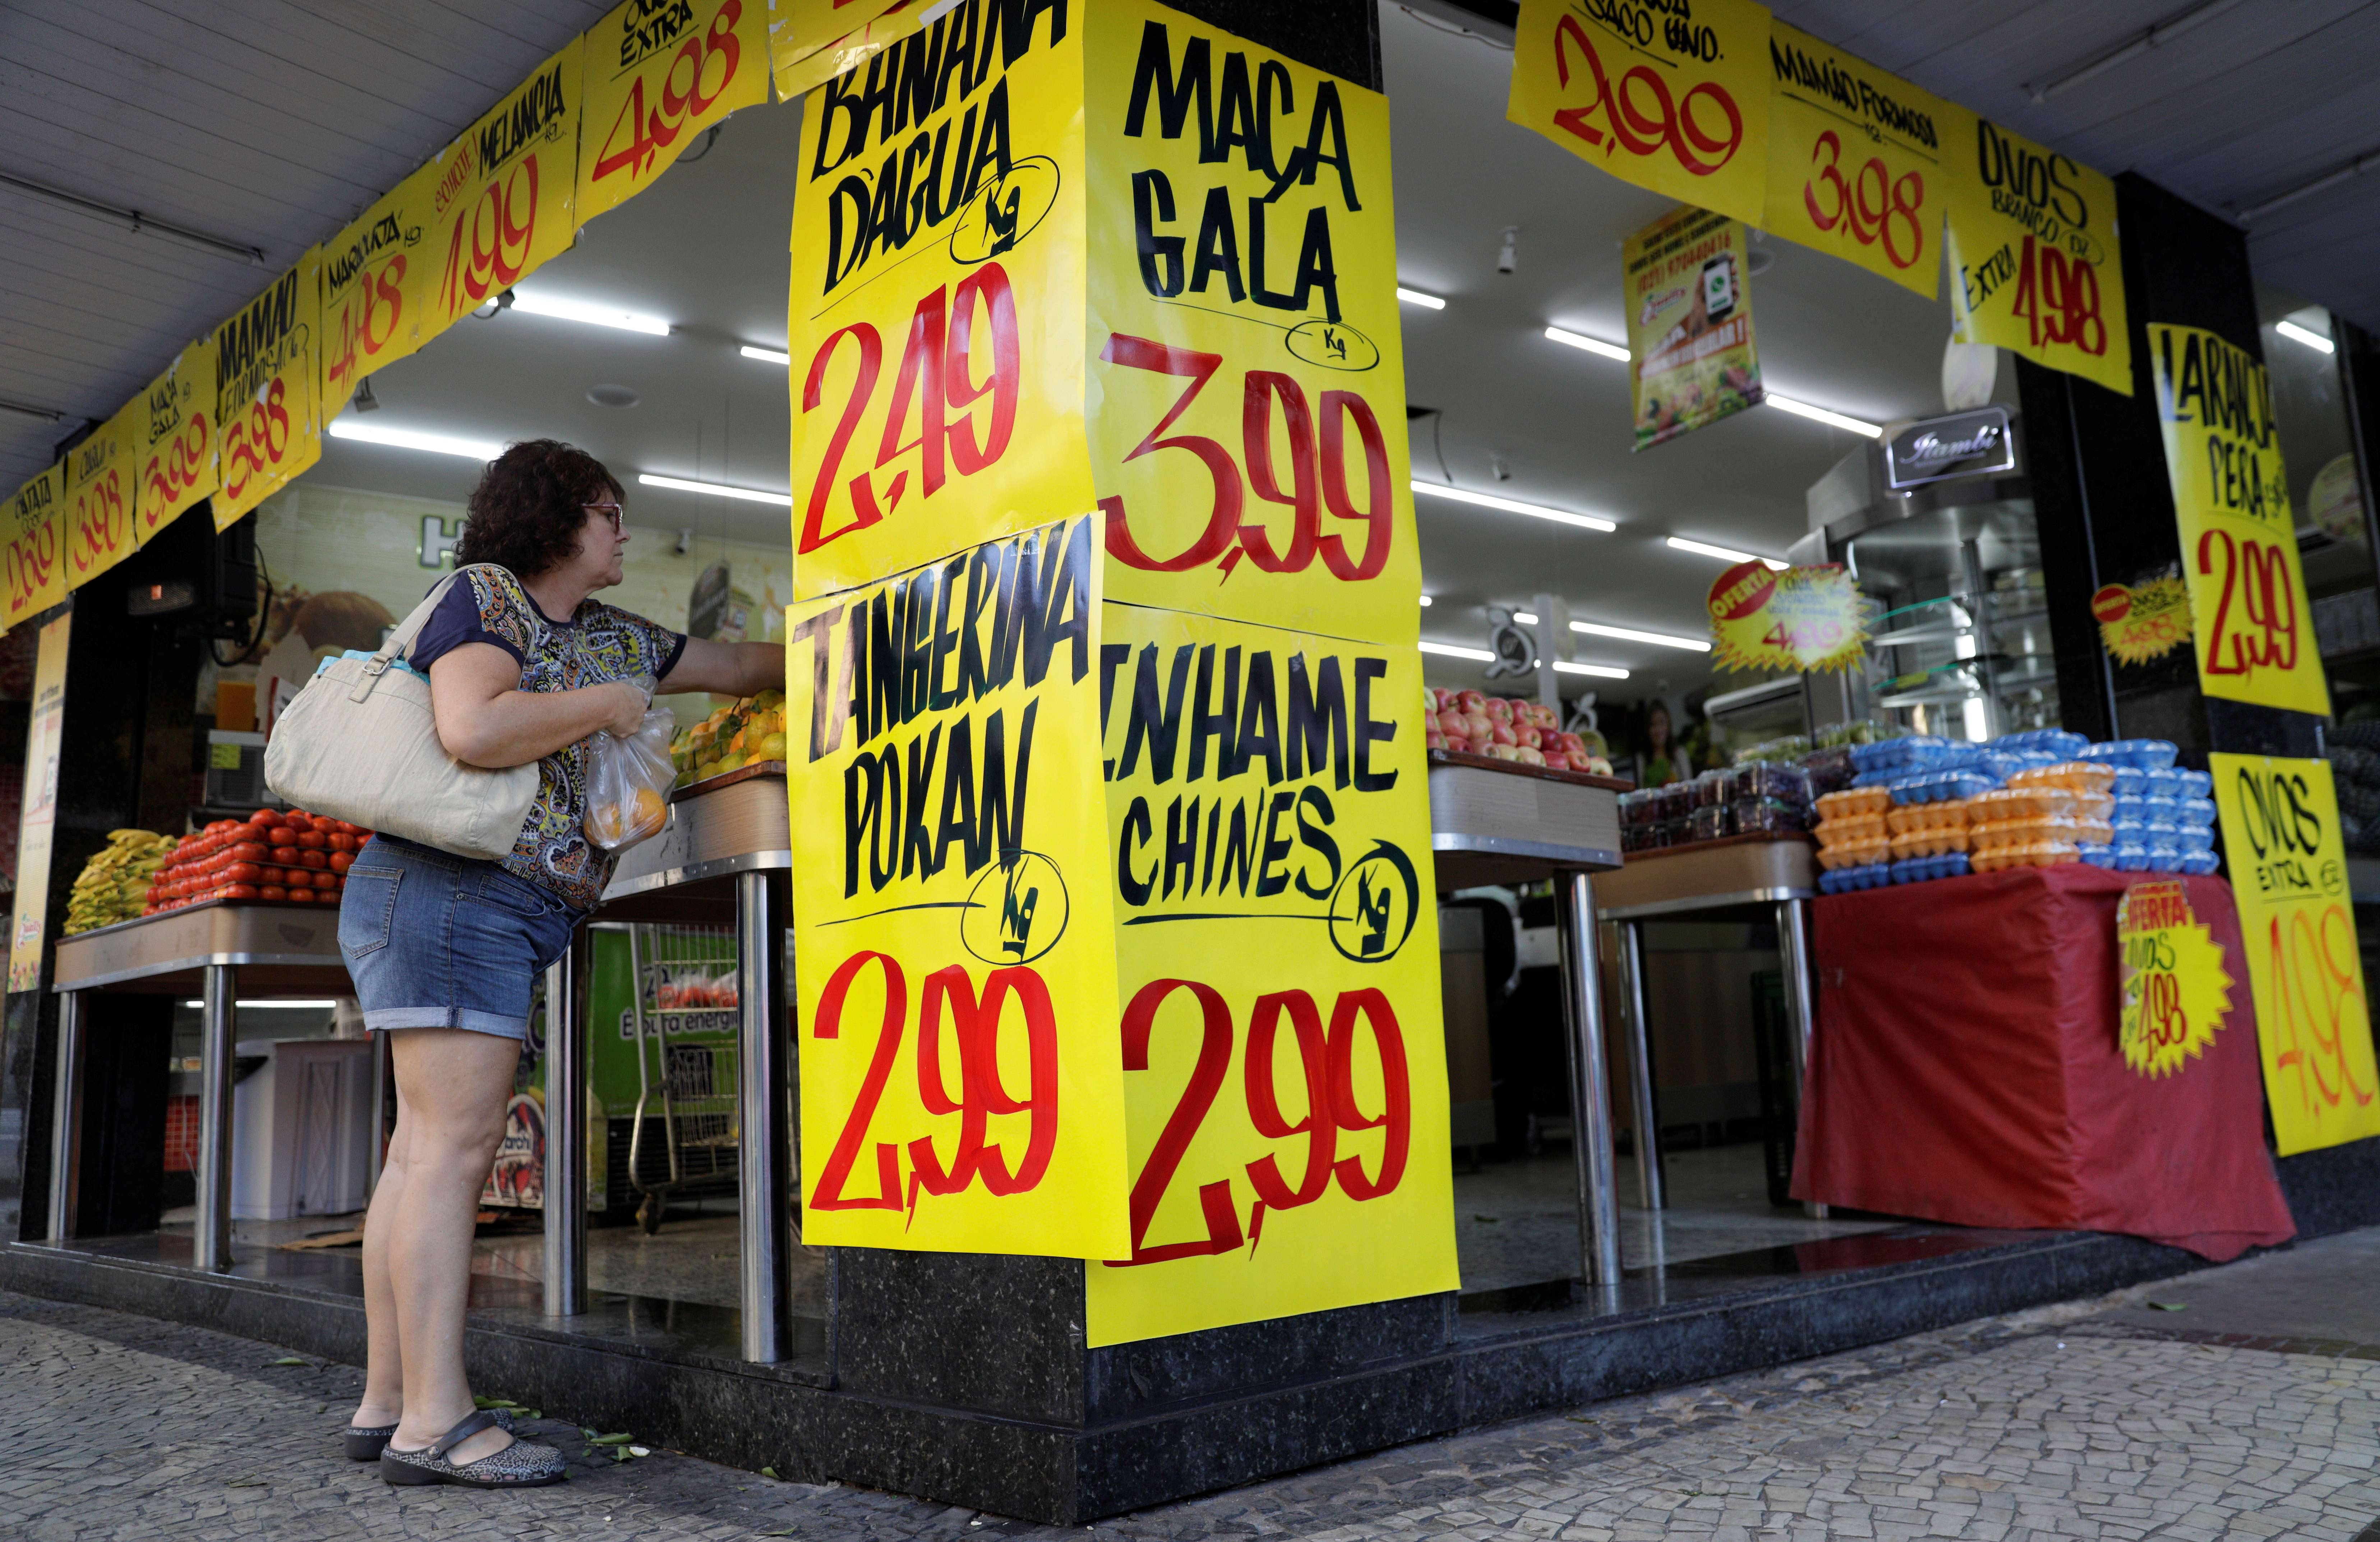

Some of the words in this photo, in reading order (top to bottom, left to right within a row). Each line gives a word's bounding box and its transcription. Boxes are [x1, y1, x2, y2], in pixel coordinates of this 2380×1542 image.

[592, 0, 742, 182] 4,98
[620, 0, 693, 67] EXTRA
[810, 0, 1068, 184] BANANA
[479, 61, 566, 182] MELANCIA
[1124, 20, 1362, 212] MAÇA
[1977, 119, 2088, 230] OVOS
[1131, 168, 1342, 324] GALA
[1804, 129, 1924, 270] 3,98
[1991, 188, 2060, 243] BRANCO
[1959, 241, 2018, 314] EXTRA
[2012, 234, 2108, 360] 4,98
[226, 377, 289, 499] 3,98
[798, 262, 1020, 555] 2,49
[1097, 332, 1392, 587] 3,99
[74, 468, 123, 572] 3,98
[2208, 434, 2267, 520] PERA
[792, 512, 1092, 763] TANGERINA
[1711, 567, 1774, 618] OFERTA
[2198, 528, 2298, 685] 2,99
[1100, 641, 1399, 793] INHAME
[844, 696, 1039, 900] POKAN
[1118, 785, 1342, 906] CHINES
[2237, 766, 2322, 860] OVOS
[2256, 860, 2313, 892] EXTRA
[623, 1008, 633, 1036] É
[684, 1010, 737, 1030] energi
[2270, 903, 2376, 1119] 4,98
[808, 950, 1058, 1234] 2,99
[1102, 978, 1411, 1267] 2,99
